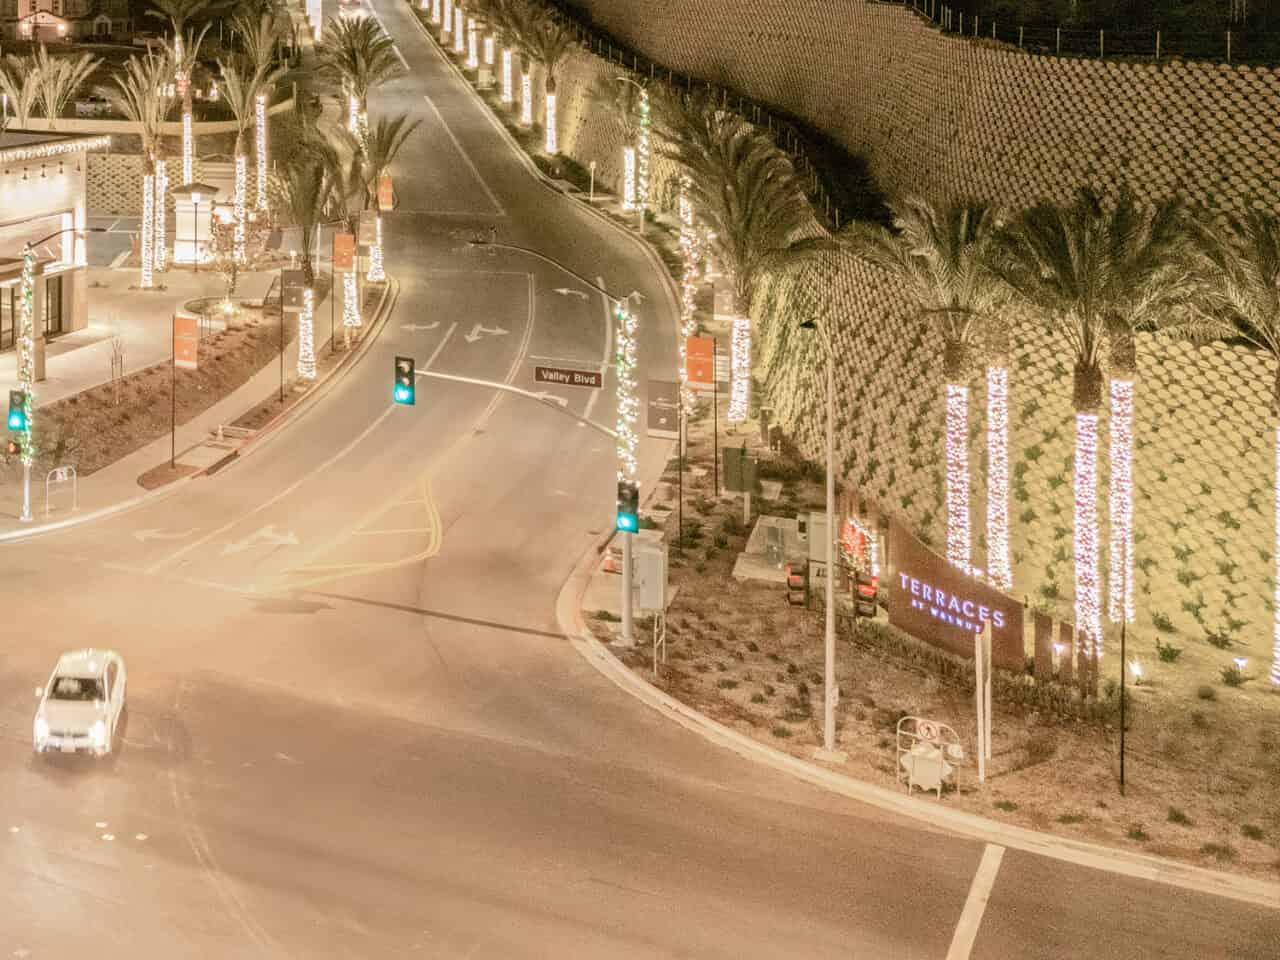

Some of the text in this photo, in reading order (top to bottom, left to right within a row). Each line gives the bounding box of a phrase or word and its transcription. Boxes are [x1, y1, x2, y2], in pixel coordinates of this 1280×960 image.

[542, 370, 596, 384] Valley Blvd
[899, 572, 1004, 628] TERRACES
